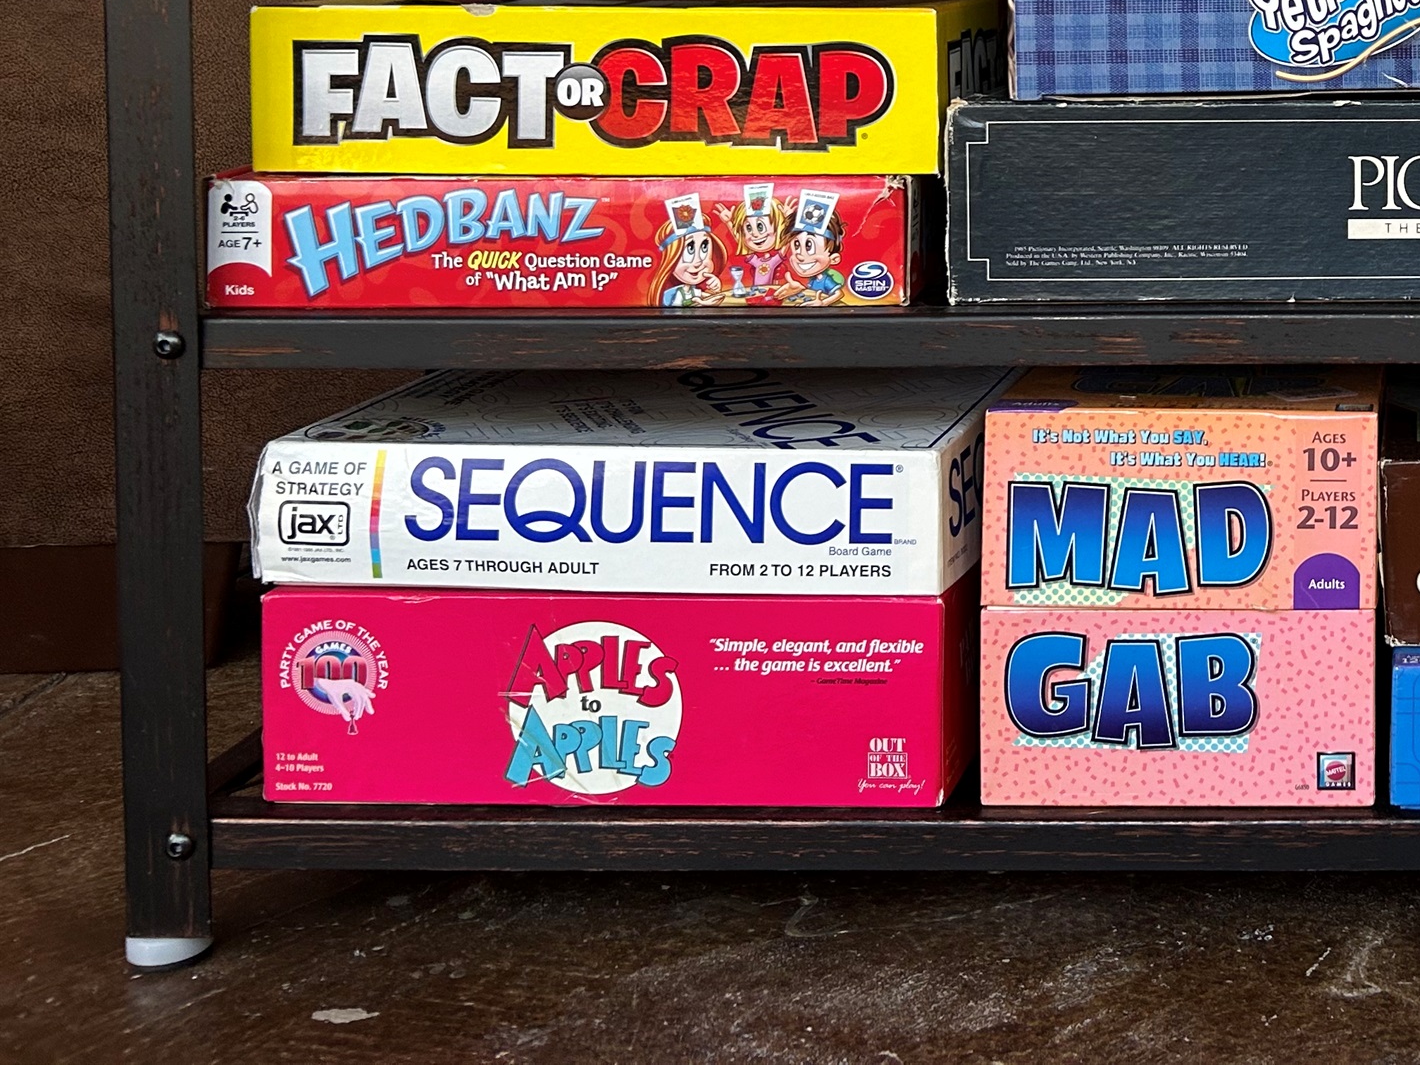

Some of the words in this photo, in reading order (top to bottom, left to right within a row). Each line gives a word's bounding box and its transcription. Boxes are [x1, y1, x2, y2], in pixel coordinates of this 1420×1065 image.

[297, 37, 568, 145] FACT
[556, 77, 604, 107] OR
[600, 40, 890, 144] CRAP
[285, 189, 604, 298] HEDBANZ
[431, 252, 463, 269] The
[467, 251, 521, 270] QUICK
[524, 252, 600, 271] Question
[603, 252, 652, 269] Game
[465, 272, 482, 287] of
[487, 271, 549, 290] "What
[553, 272, 586, 290] Am
[1032, 428, 1058, 444] It's
[1062, 428, 1090, 444] Not
[1093, 428, 1136, 444] What
[1139, 429, 1170, 445] You
[404, 456, 894, 545] SEQUENCE
[1006, 480, 1272, 597] MAD
[407, 558, 450, 571] AGES
[453, 560, 462, 571] 7
[463, 559, 544, 573] THROUGH
[547, 562, 600, 575] ADULT
[505, 623, 680, 708] APPLES
[772, 639, 832, 656] elegant,
[835, 639, 865, 653] and
[866, 639, 924, 657] flexible
[580, 696, 602, 713] to
[1004, 631, 1259, 750] GAB
[504, 704, 677, 788] APPLES
